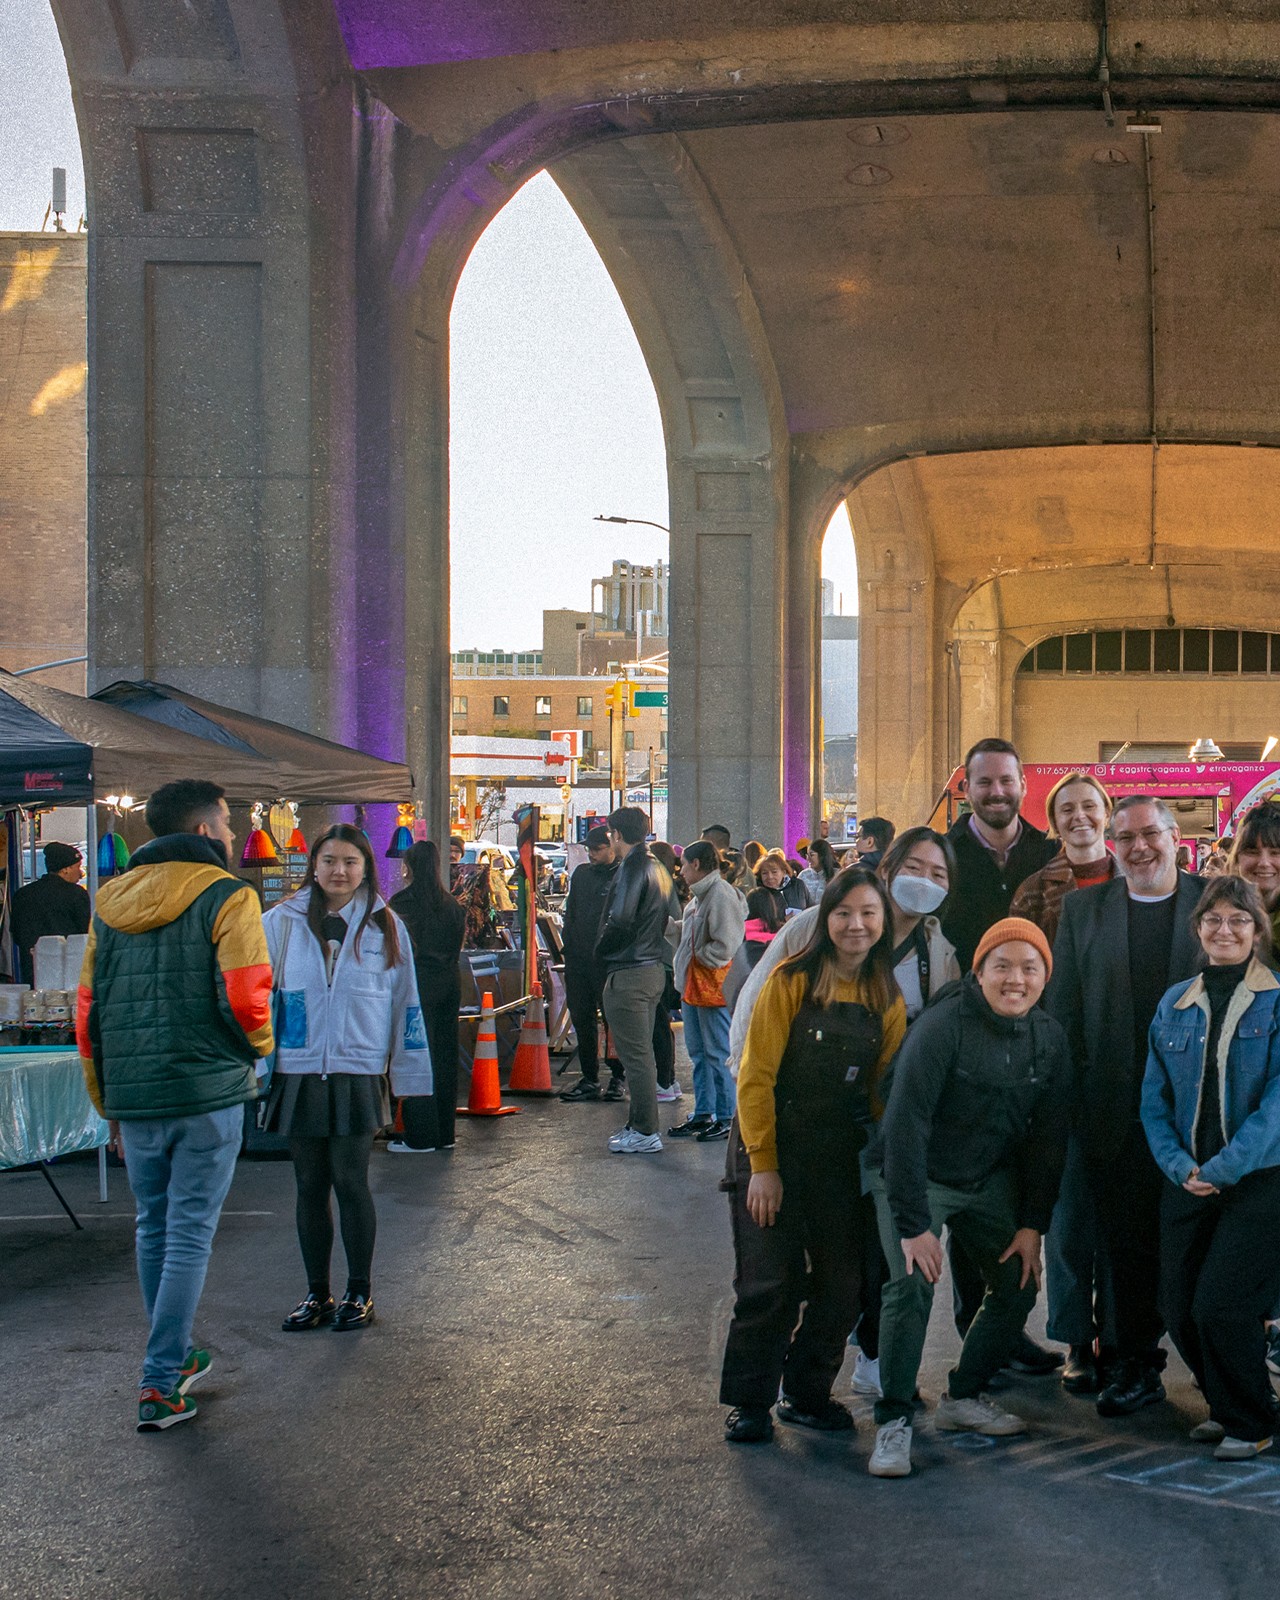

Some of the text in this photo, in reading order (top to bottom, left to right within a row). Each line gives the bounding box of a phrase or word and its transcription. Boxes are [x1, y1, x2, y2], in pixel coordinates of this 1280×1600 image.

[1036, 766, 1091, 775] 917.6570987
[1119, 765, 1191, 774] eggstravaganza
[1209, 764, 1266, 773] etravaganza
